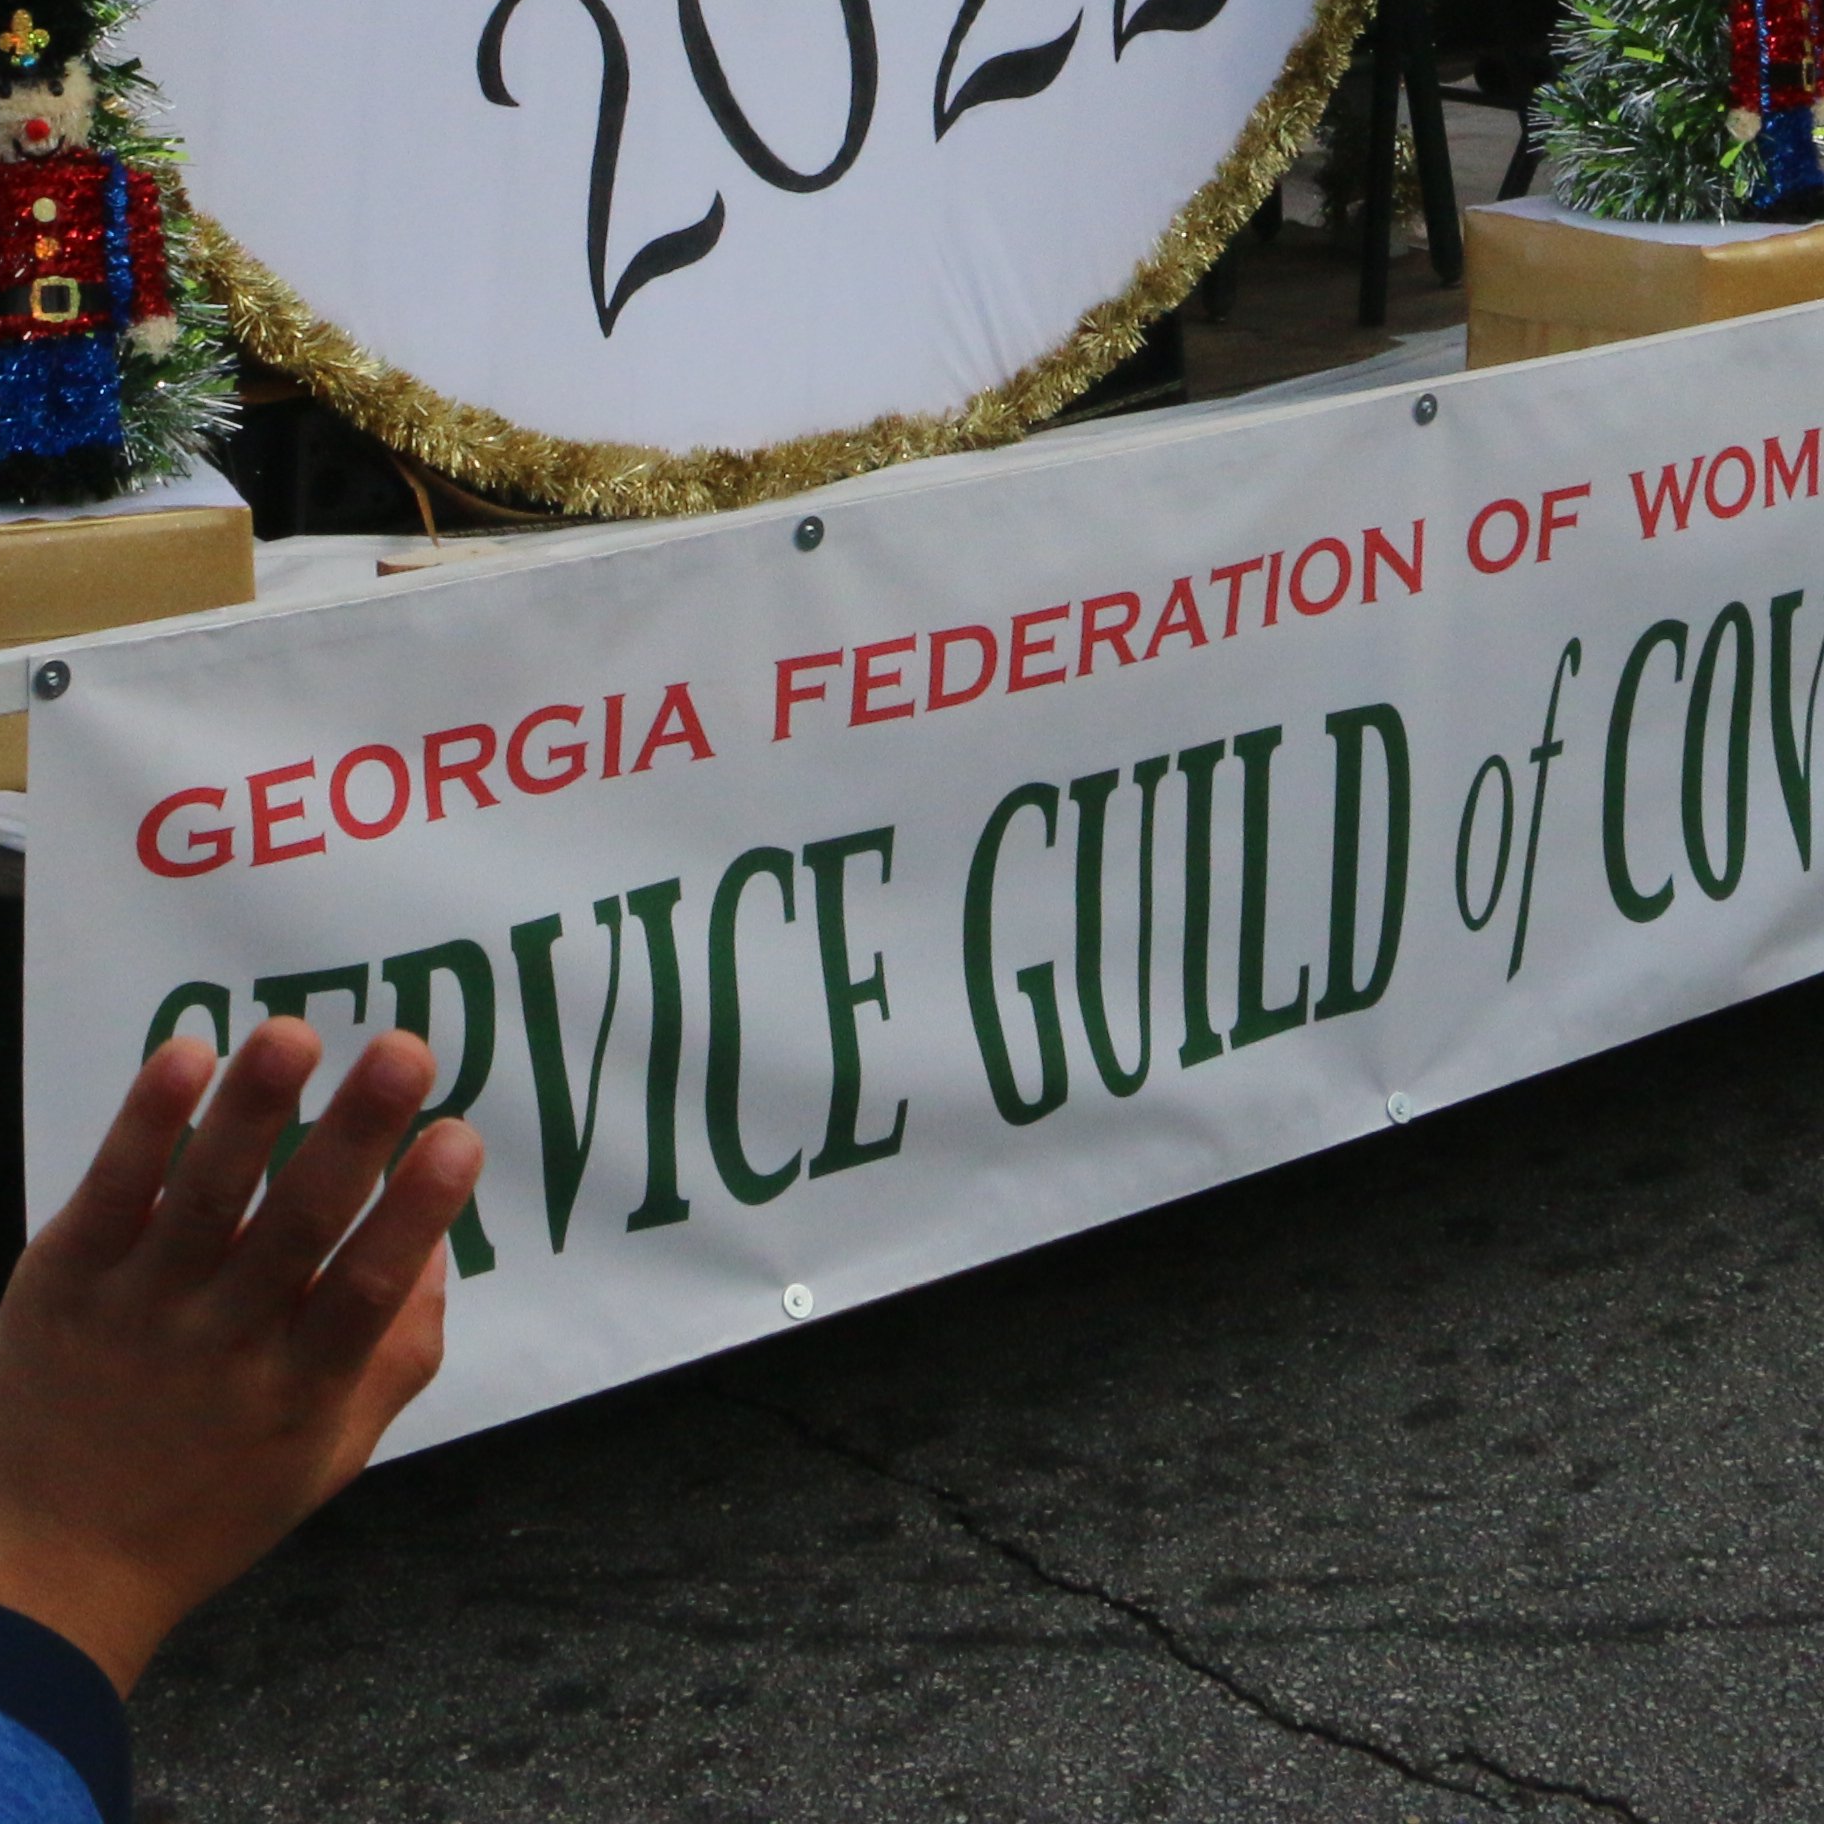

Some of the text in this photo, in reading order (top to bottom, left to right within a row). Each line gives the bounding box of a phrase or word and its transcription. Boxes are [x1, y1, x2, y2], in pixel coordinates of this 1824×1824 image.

[137, 681, 715, 879] GEORGIA
[773, 518, 1428, 742] FEDERATION
[1467, 483, 1592, 574] OF
[962, 701, 1412, 1124] GUILD
[1454, 636, 1583, 982] of
